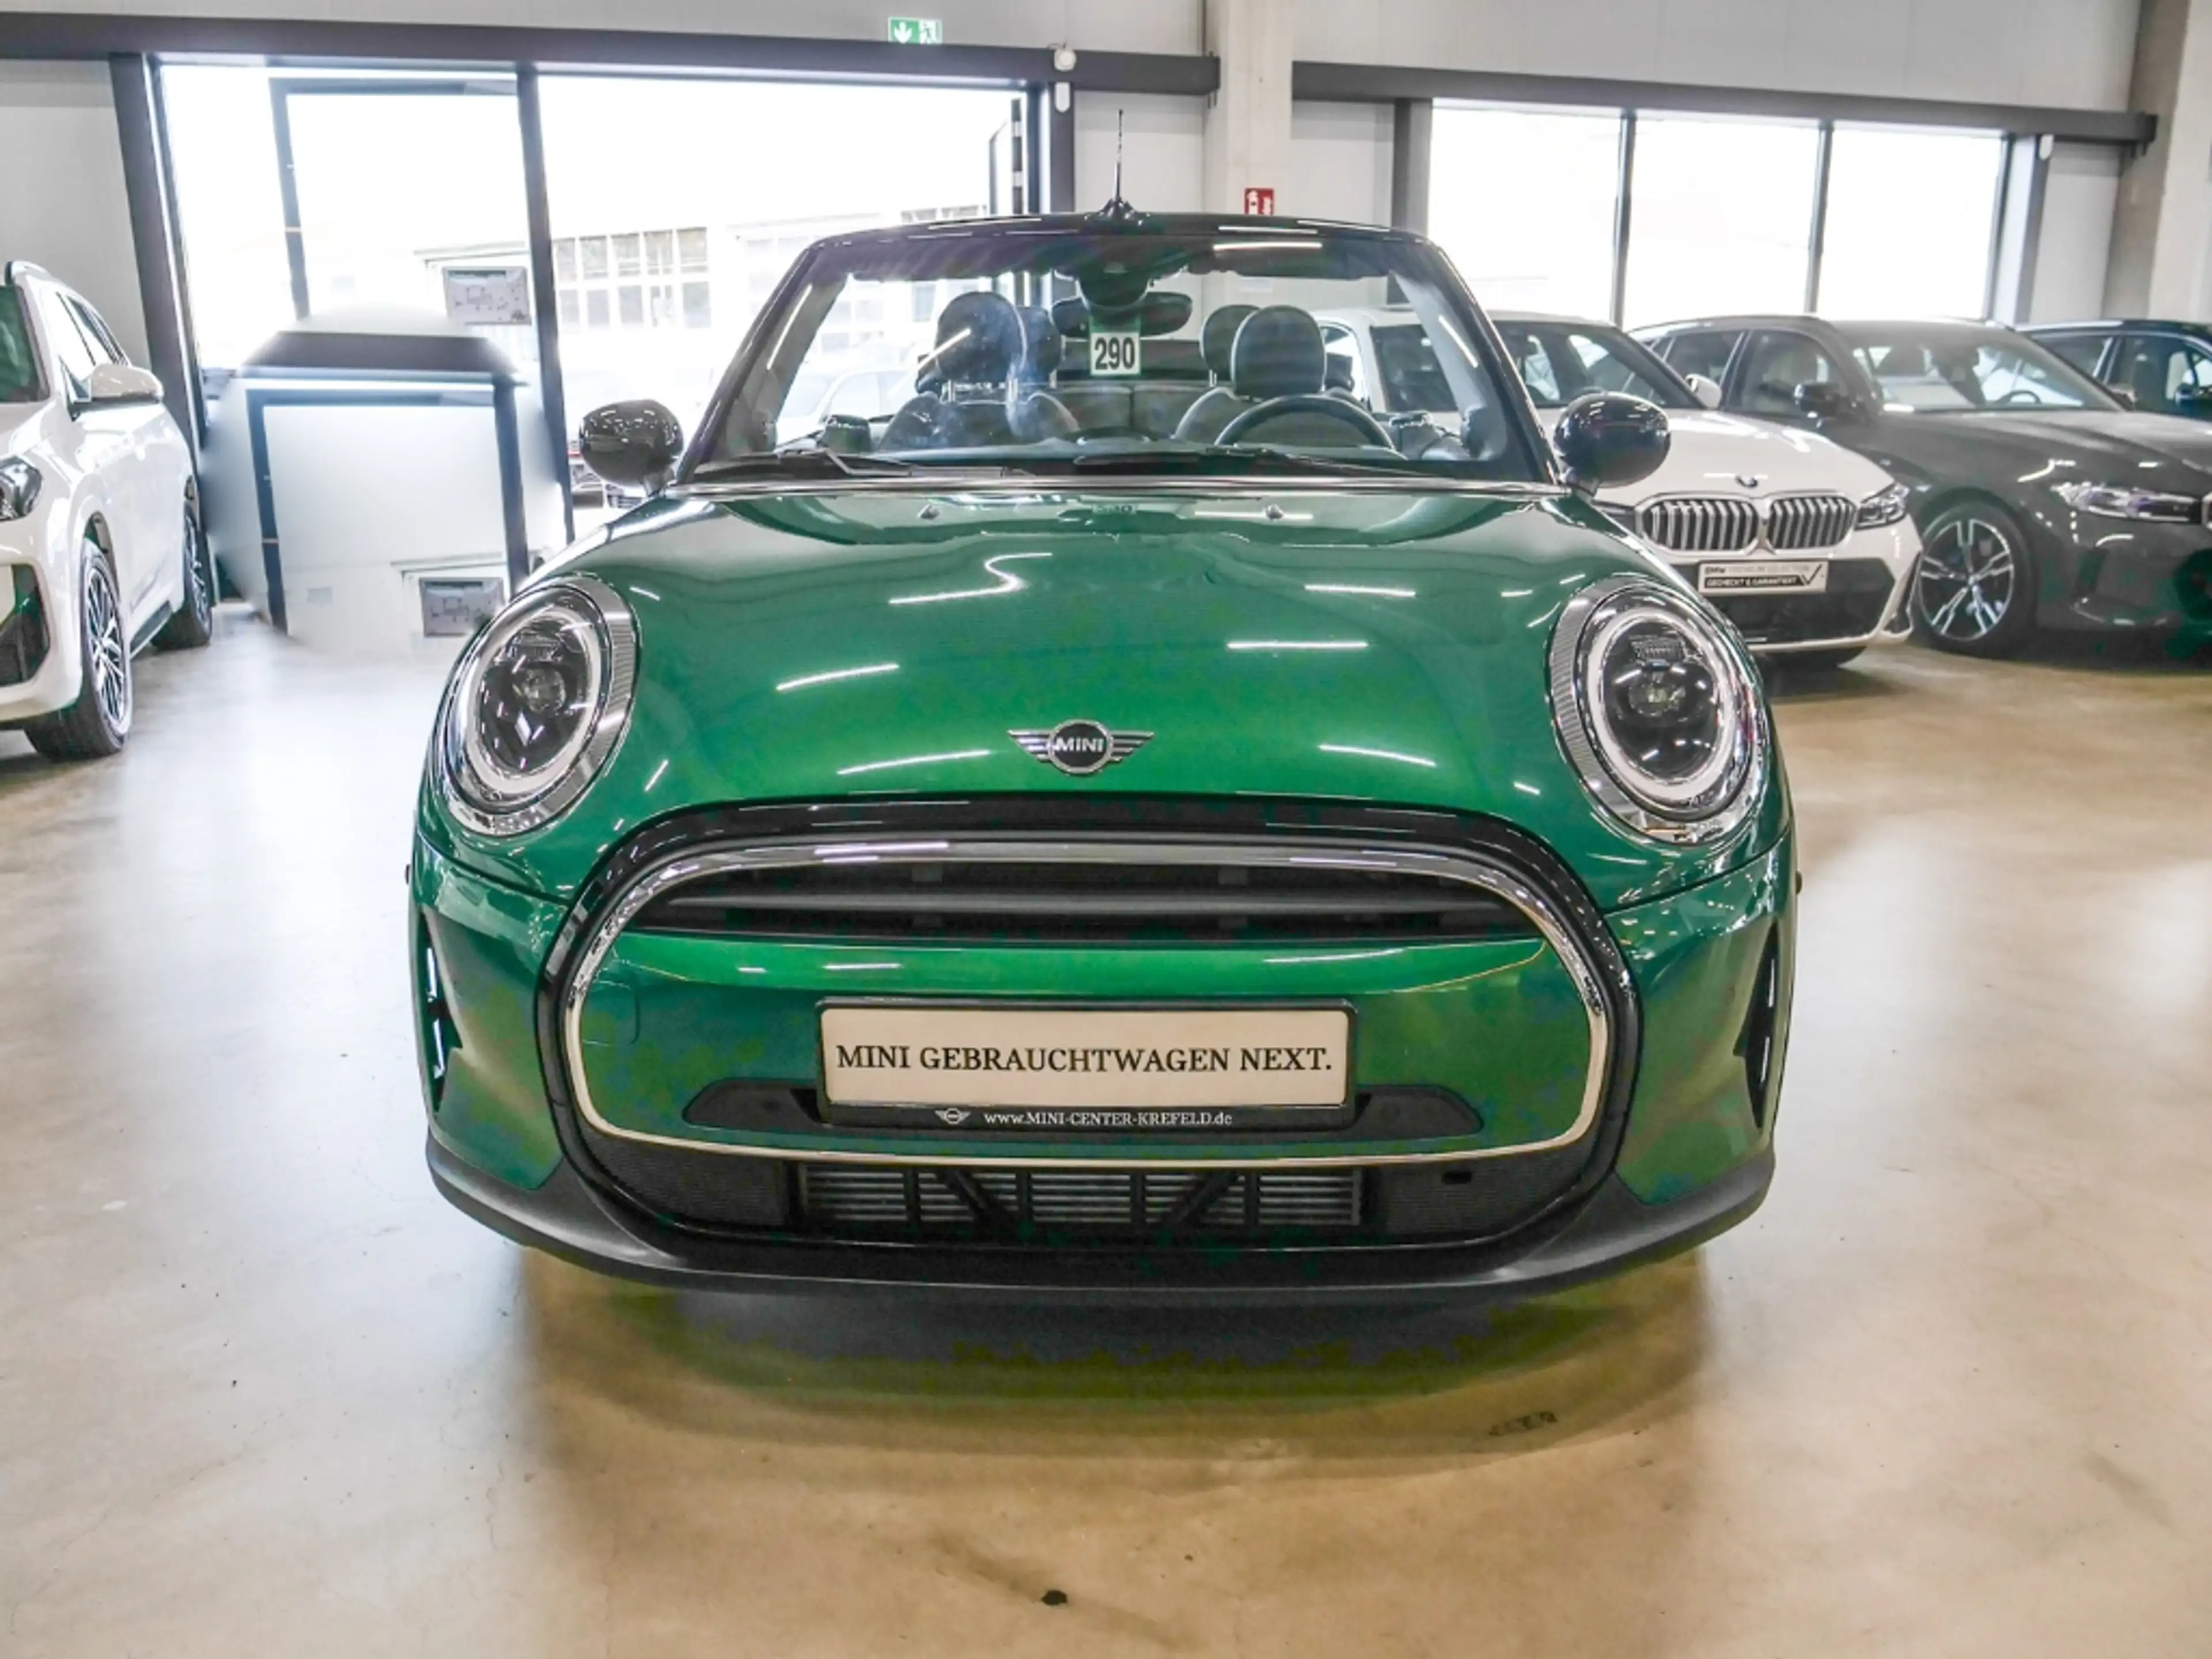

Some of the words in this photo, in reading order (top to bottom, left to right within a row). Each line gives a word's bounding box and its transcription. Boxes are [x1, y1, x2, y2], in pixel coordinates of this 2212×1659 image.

[1095, 336, 1135, 370] 290
[1055, 737, 1105, 752] MINI
[836, 1045, 910, 1069] MINI
[920, 1047, 1230, 1072] GEBRAUCHTWAGEN
[1240, 1048, 1332, 1071] NEXT.
[983, 1112, 1232, 1126] www.MINI-CENTER-KREFELD.de
